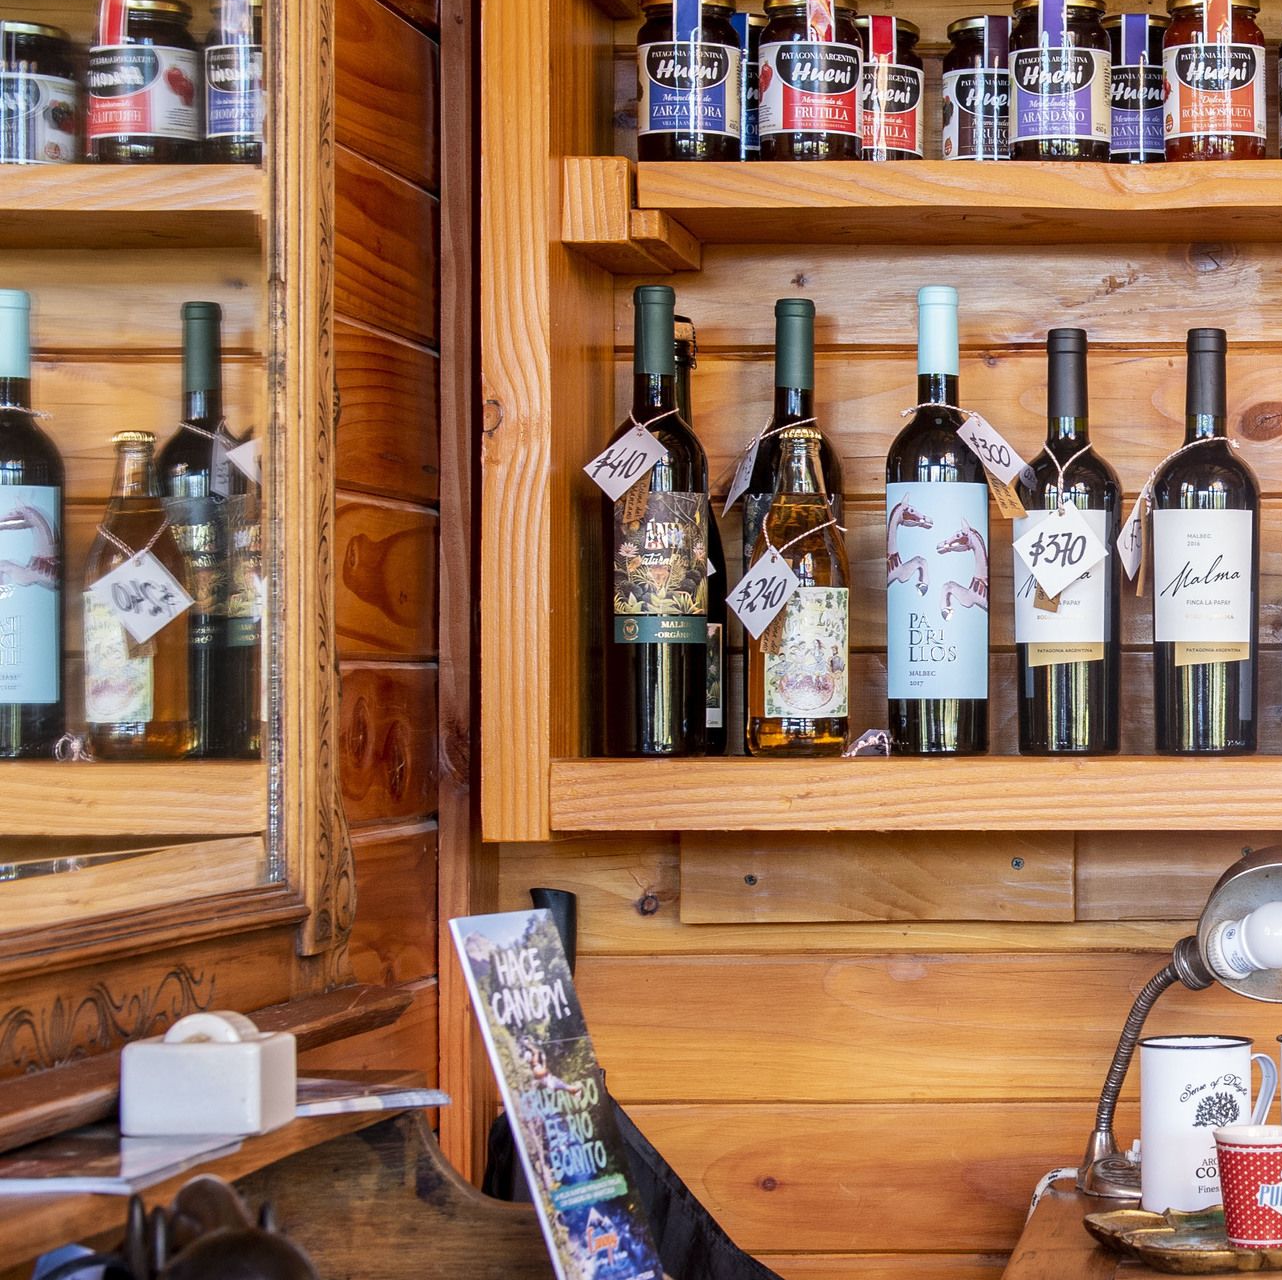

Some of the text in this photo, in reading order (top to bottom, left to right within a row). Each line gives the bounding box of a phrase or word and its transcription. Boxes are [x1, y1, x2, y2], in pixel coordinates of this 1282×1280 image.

[781, 52, 857, 64] PATAGONIA ARGENTINA
[657, 60, 718, 79] Hueni
[792, 63, 851, 84] Hueni
[1023, 66, 1083, 85] Hueni
[1186, 62, 1247, 81] Hueni
[1111, 83, 1164, 101] Hueni
[794, 107, 848, 121] FRUTILLA
[1182, 108, 1204, 118] ROSA
[969, 433, 1011, 468] $300
[1028, 531, 1088, 568] $370
[1160, 554, 1241, 597] Malma
[737, 577, 789, 615] $240
[909, 613, 930, 628] PA
[909, 630, 944, 645] DRI
[909, 646, 957, 662] LLOS
[494, 948, 544, 987] HACE
[492, 979, 572, 1026] CANOPY!
[519, 1077, 599, 1120] CRUZANDO
[1180, 1081, 1207, 1103] Sense
[551, 1140, 608, 1182] BONITO
